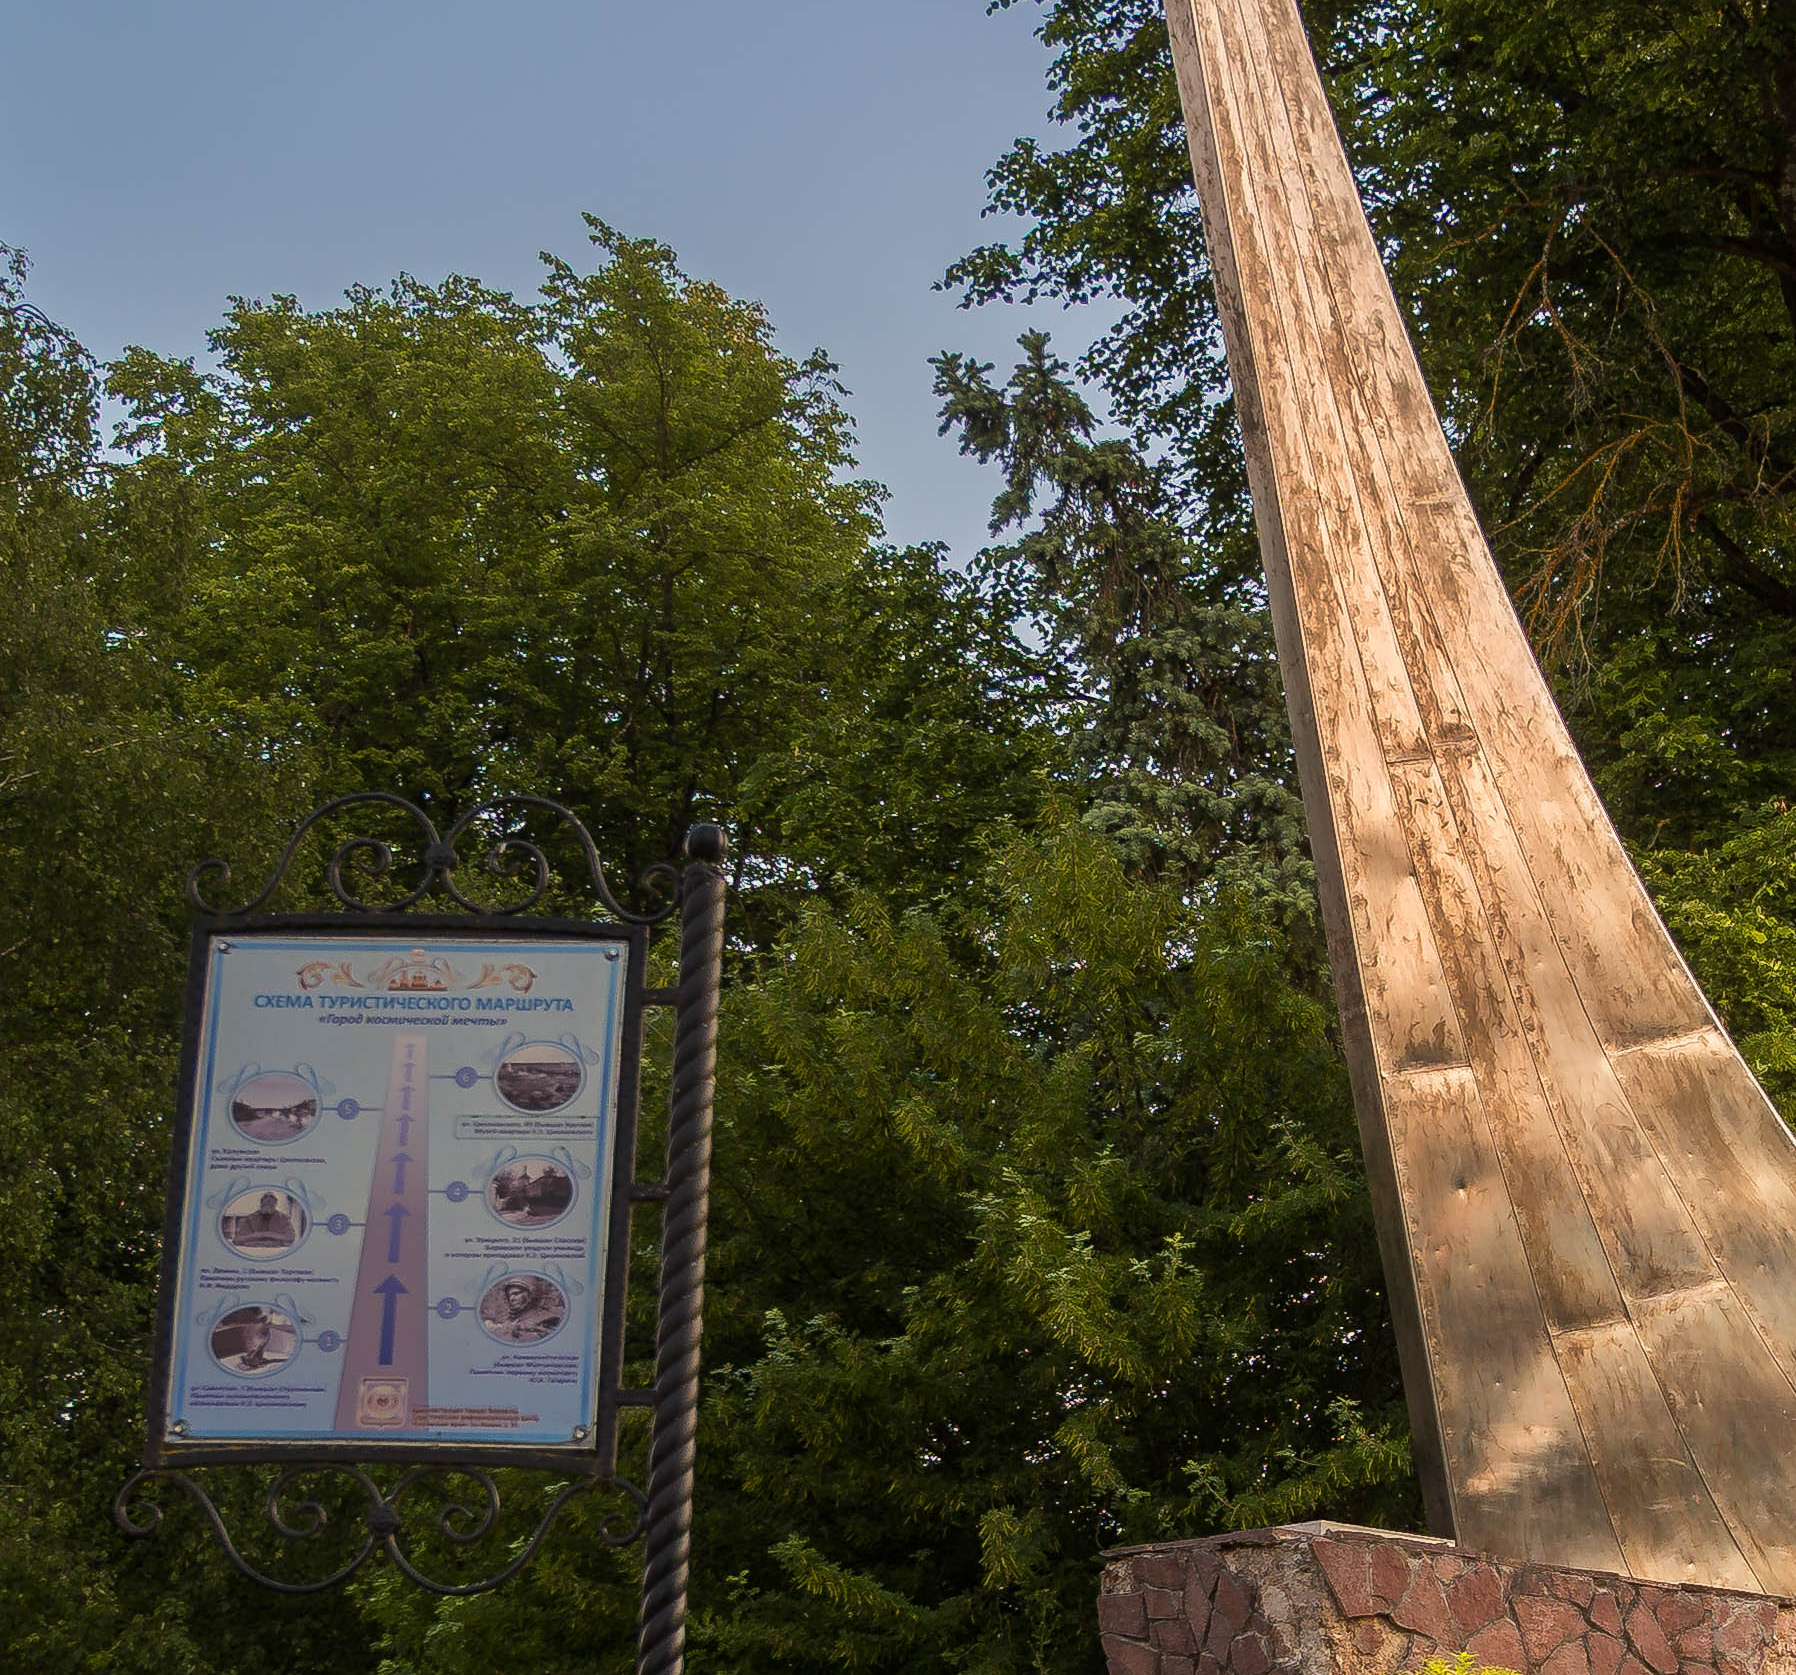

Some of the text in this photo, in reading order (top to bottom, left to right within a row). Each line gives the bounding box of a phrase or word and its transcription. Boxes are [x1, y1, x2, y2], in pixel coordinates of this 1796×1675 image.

[253, 994, 574, 1012] СХЕМА ТУРИСТИЧЕСКОГО МАРШРУТА
[318, 1012, 509, 1027] «Город космической мечты»
[344, 1104, 352, 1114] 5
[336, 1219, 343, 1230] 3
